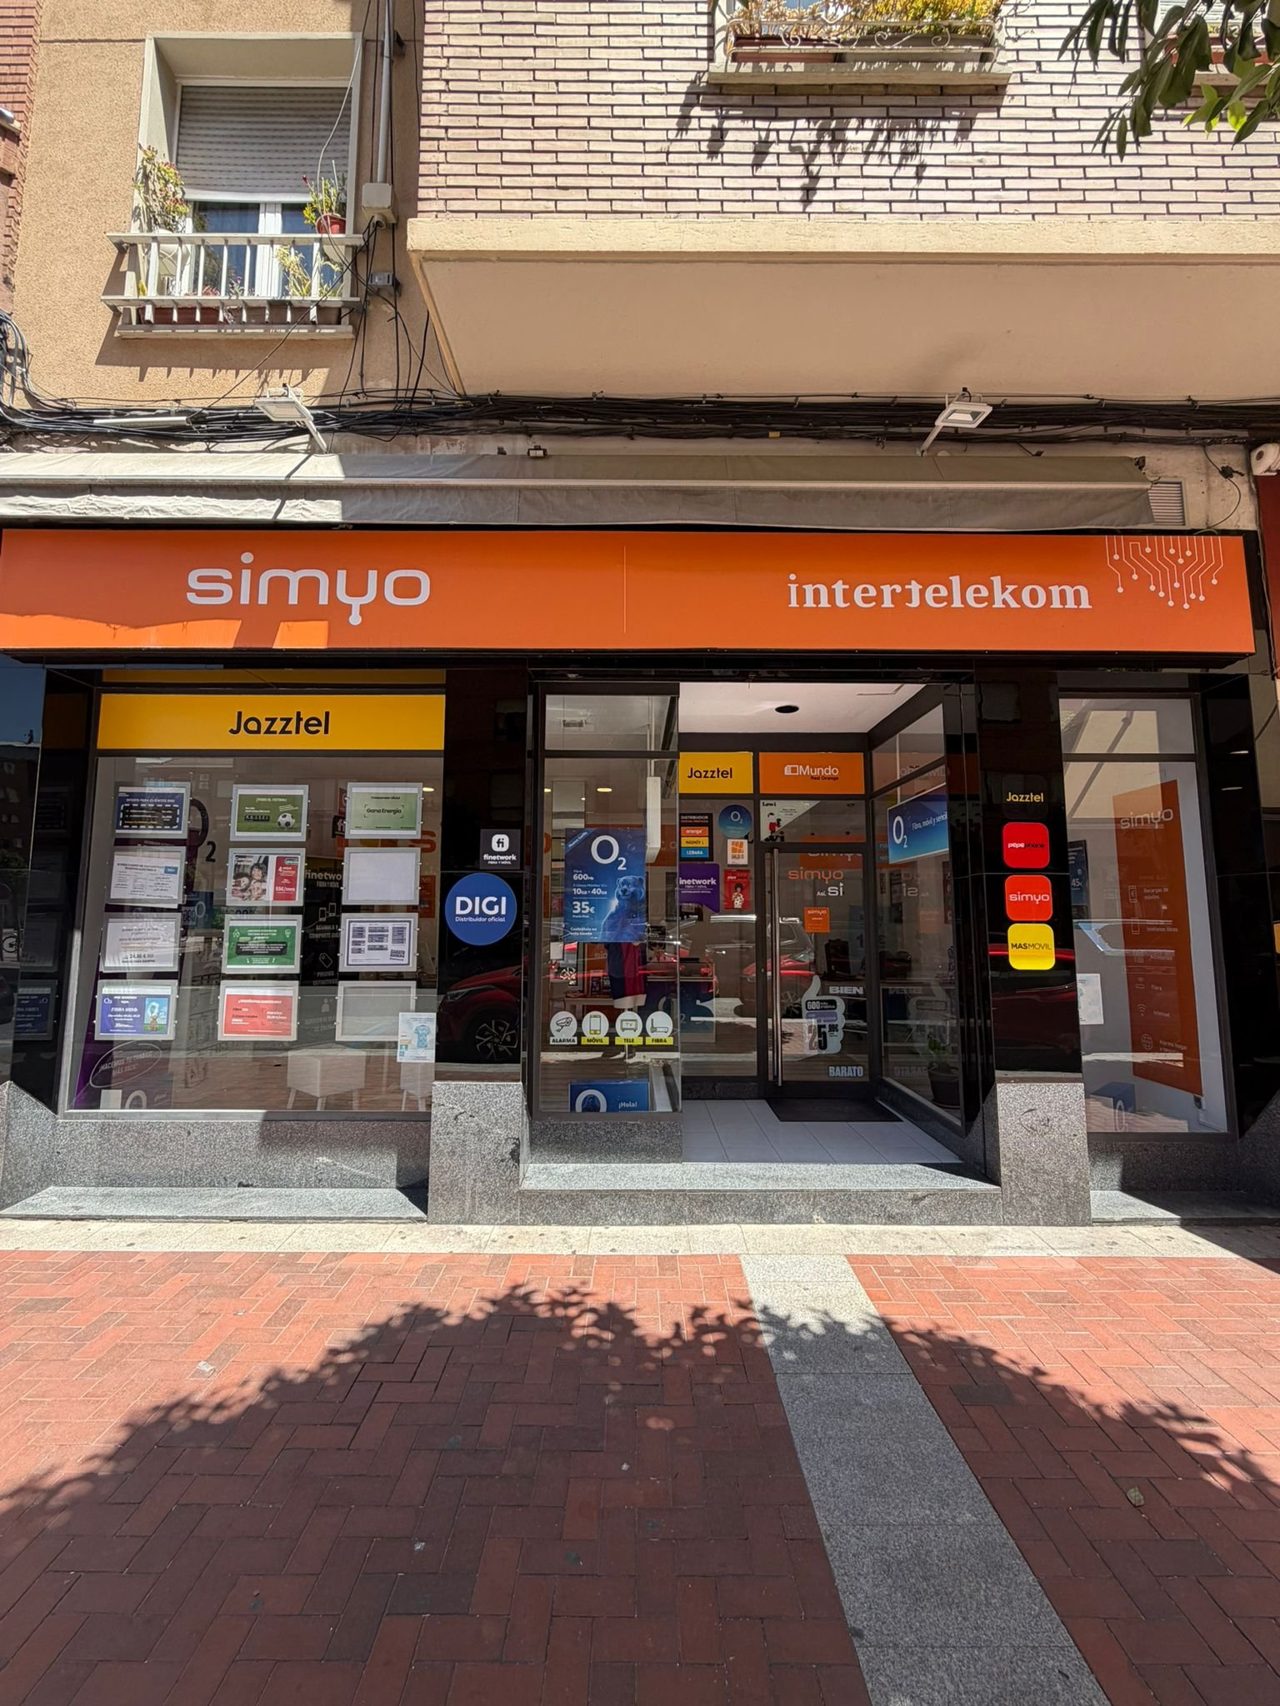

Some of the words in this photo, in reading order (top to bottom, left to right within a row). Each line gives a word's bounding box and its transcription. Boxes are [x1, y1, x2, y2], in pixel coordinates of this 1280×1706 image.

[186, 552, 431, 626] simyo
[788, 573, 1093, 609] intertelekom
[229, 711, 330, 735] Jazztel
[687, 767, 733, 779] Jazztel
[800, 765, 839, 776] Mundo
[1006, 792, 1044, 803] Jazztel
[1120, 809, 1174, 829] simyo
[591, 835, 627, 870] O2
[679, 877, 717, 885] inetwork
[788, 867, 844, 884] simyo
[1009, 892, 1049, 904] simyo
[455, 896, 507, 916] DIGI
[572, 901, 595, 914] 35€
[829, 986, 864, 994] BIEN
[828, 1066, 864, 1077] BARATO
